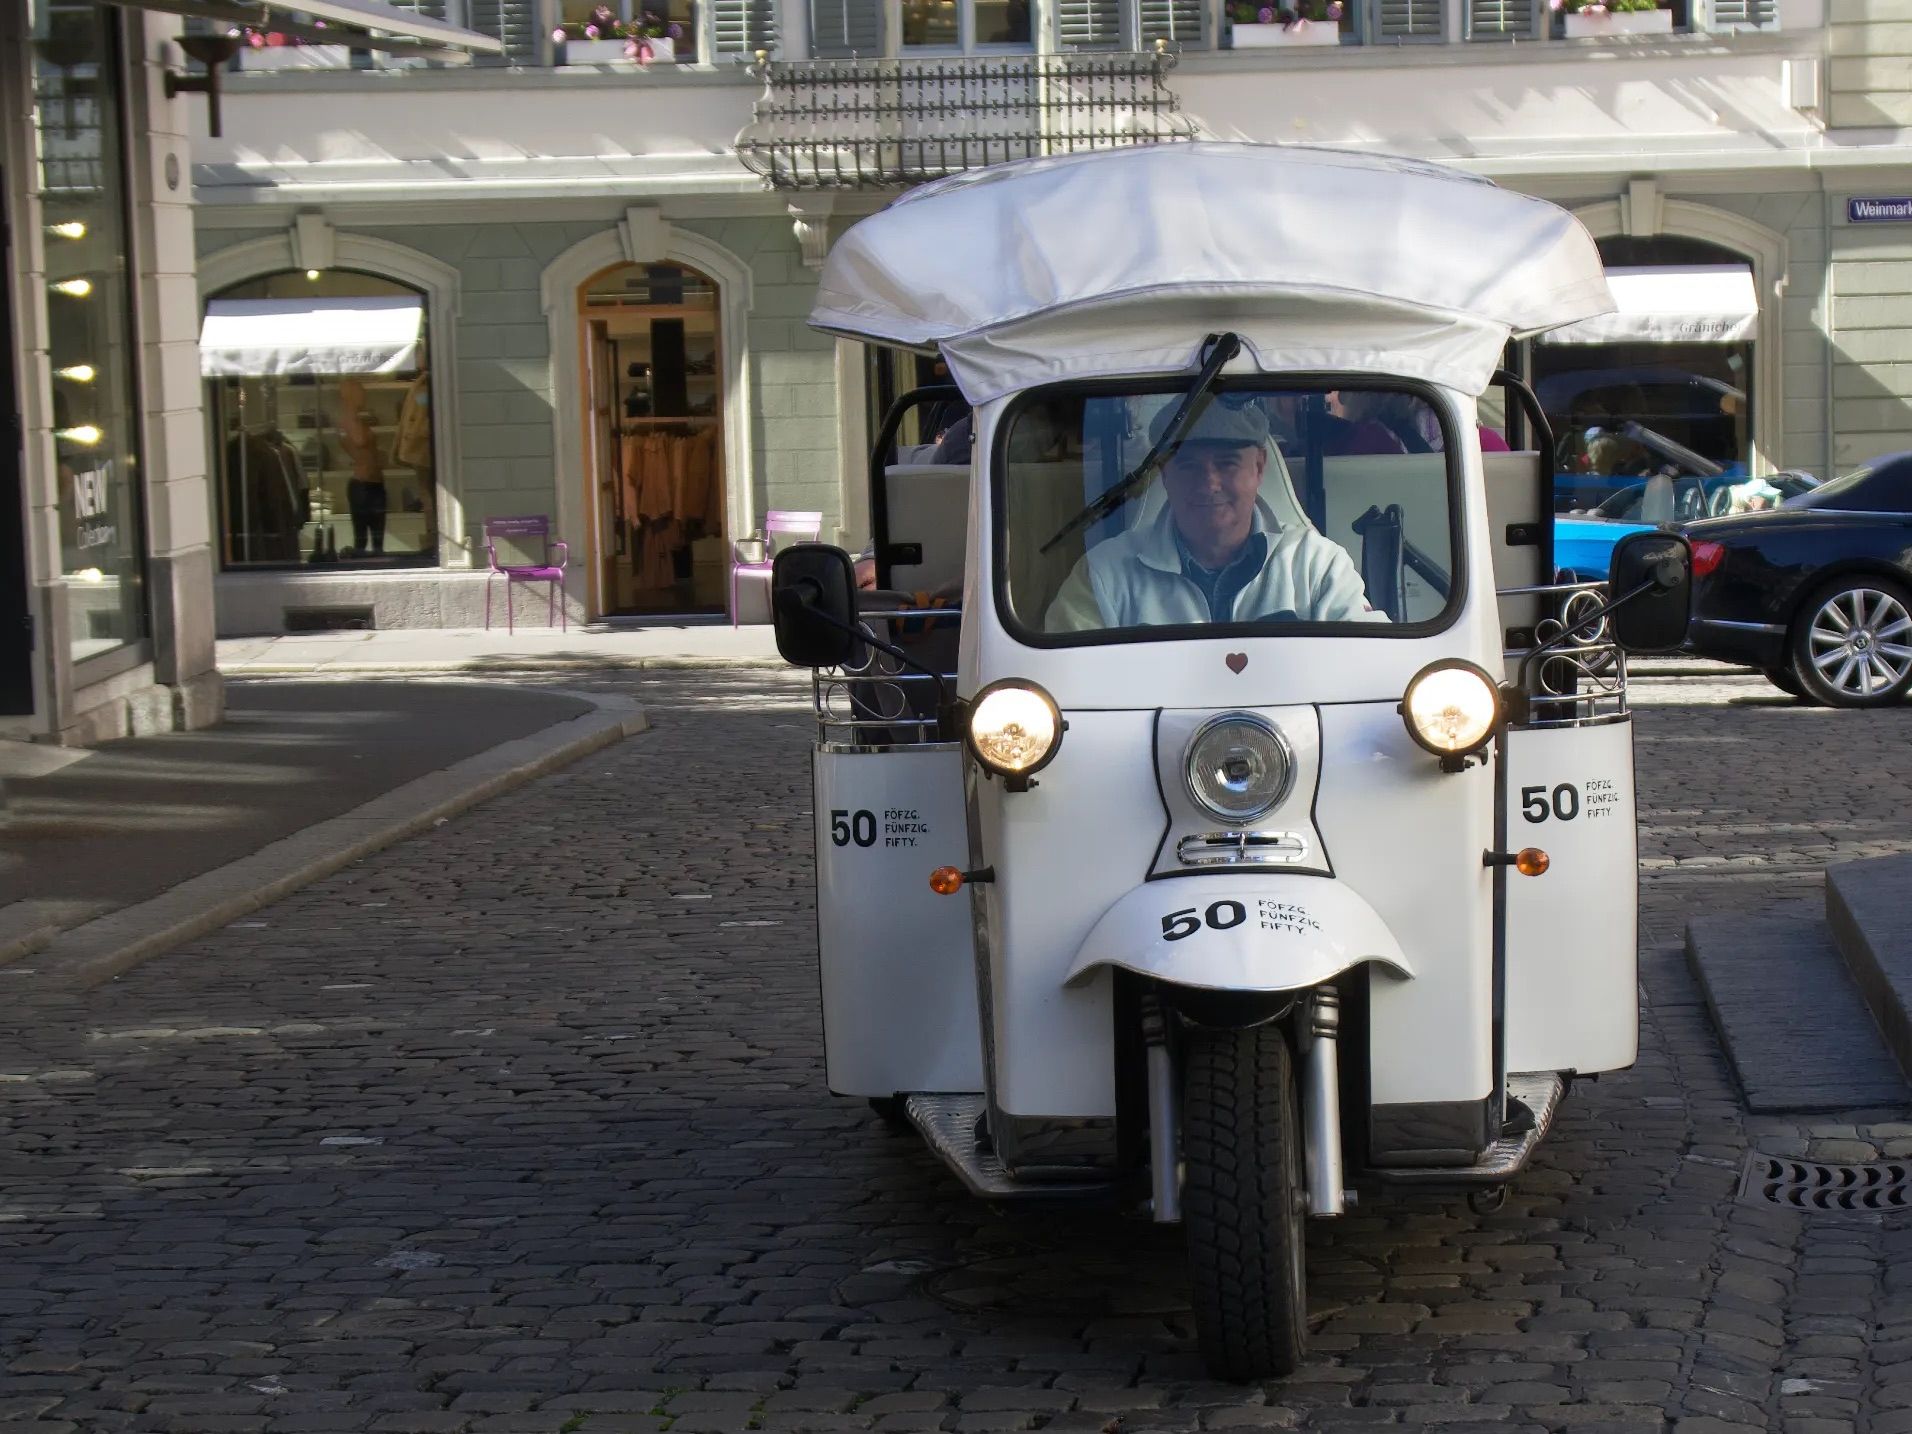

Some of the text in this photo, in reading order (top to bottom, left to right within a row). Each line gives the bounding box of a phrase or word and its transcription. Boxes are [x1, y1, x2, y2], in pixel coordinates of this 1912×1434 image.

[73, 470, 108, 519] NEW
[884, 808, 921, 820] FÖFZG.
[1521, 782, 1580, 824] 50
[831, 809, 877, 848] 50
[885, 821, 930, 833] FÜNFZIG.
[885, 837, 918, 848] FIFTY.
[1161, 899, 1247, 942] 50
[1261, 921, 1306, 935] FIFTY.
